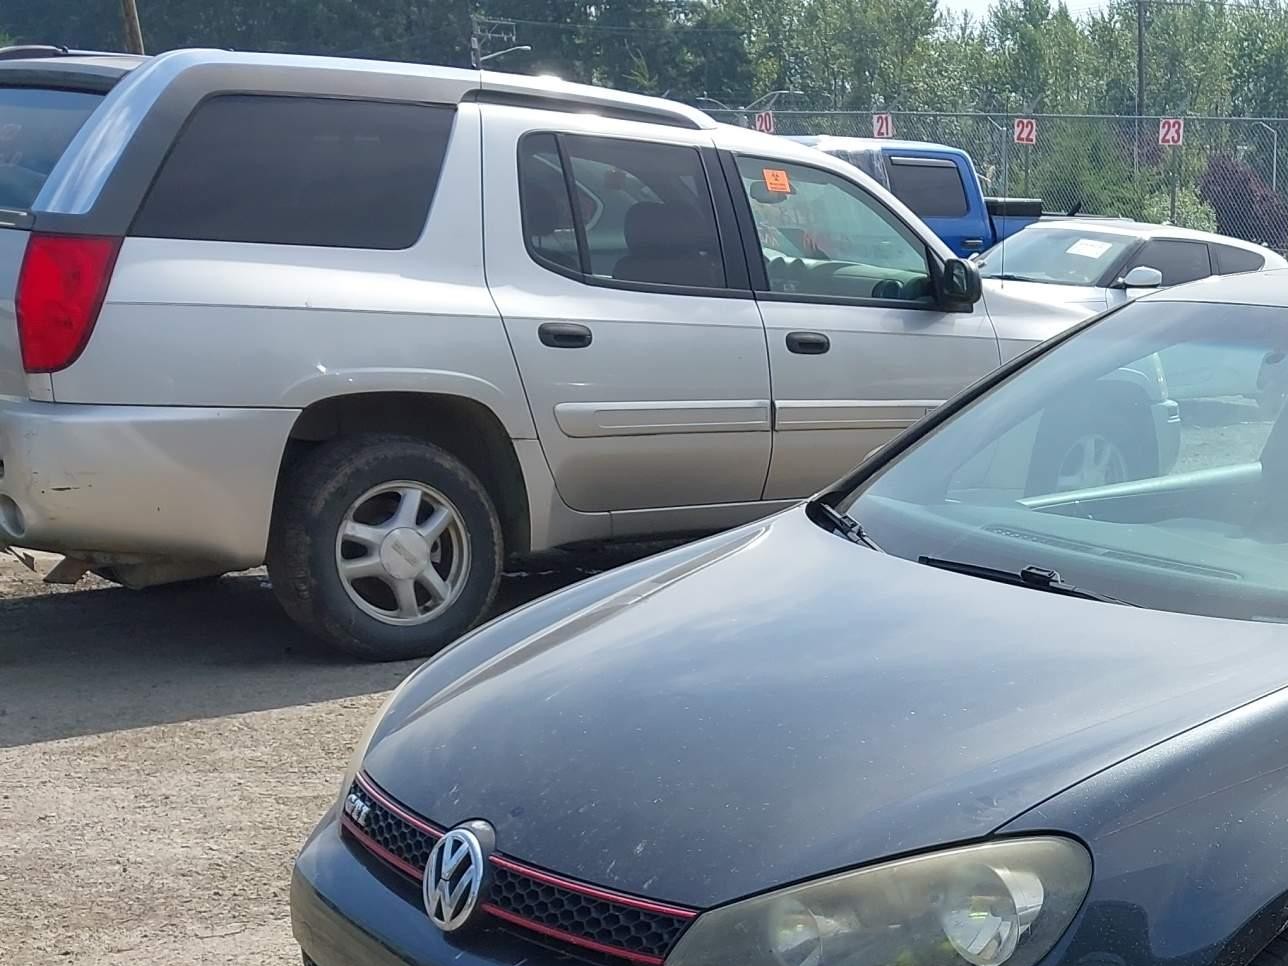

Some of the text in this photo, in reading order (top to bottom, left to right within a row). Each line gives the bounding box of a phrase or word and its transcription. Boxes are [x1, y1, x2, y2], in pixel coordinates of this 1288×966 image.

[756, 113, 772, 132] 20
[876, 116, 889, 136] 21
[1016, 120, 1034, 142] 22
[1161, 121, 1181, 143] 23
